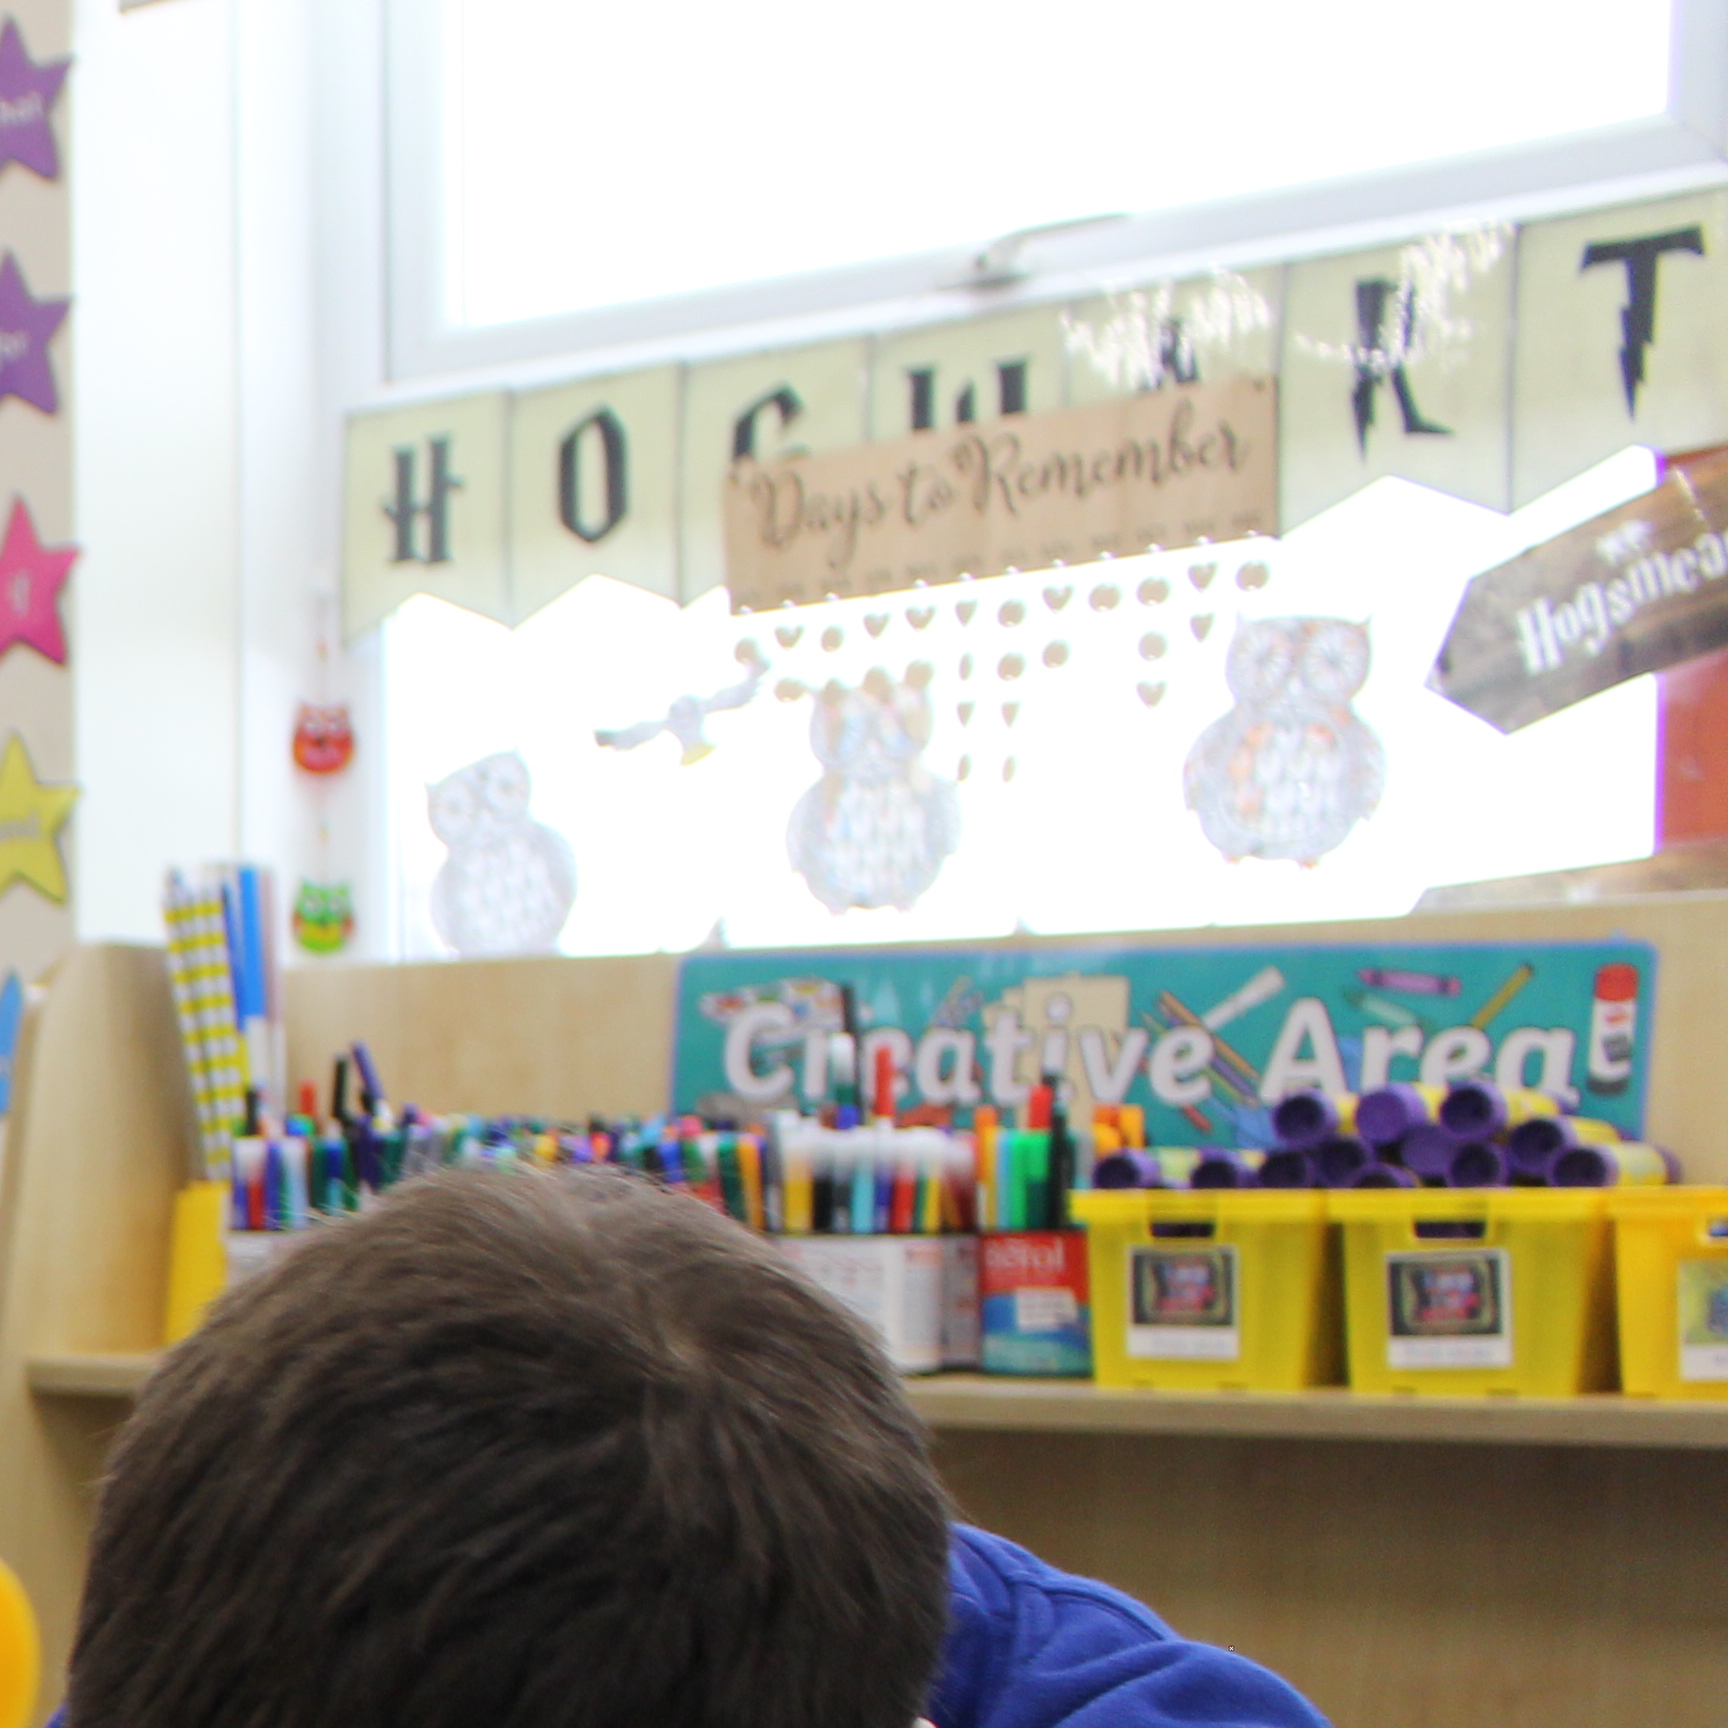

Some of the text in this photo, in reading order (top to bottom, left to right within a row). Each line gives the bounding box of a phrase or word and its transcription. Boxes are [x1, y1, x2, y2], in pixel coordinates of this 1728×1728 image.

[748, 468, 885, 569] Days
[899, 466, 959, 526] to
[952, 397, 1254, 518] Remember
[1516, 530, 1728, 675] Hogsmea
[722, 992, 1582, 1104] Creative Area
